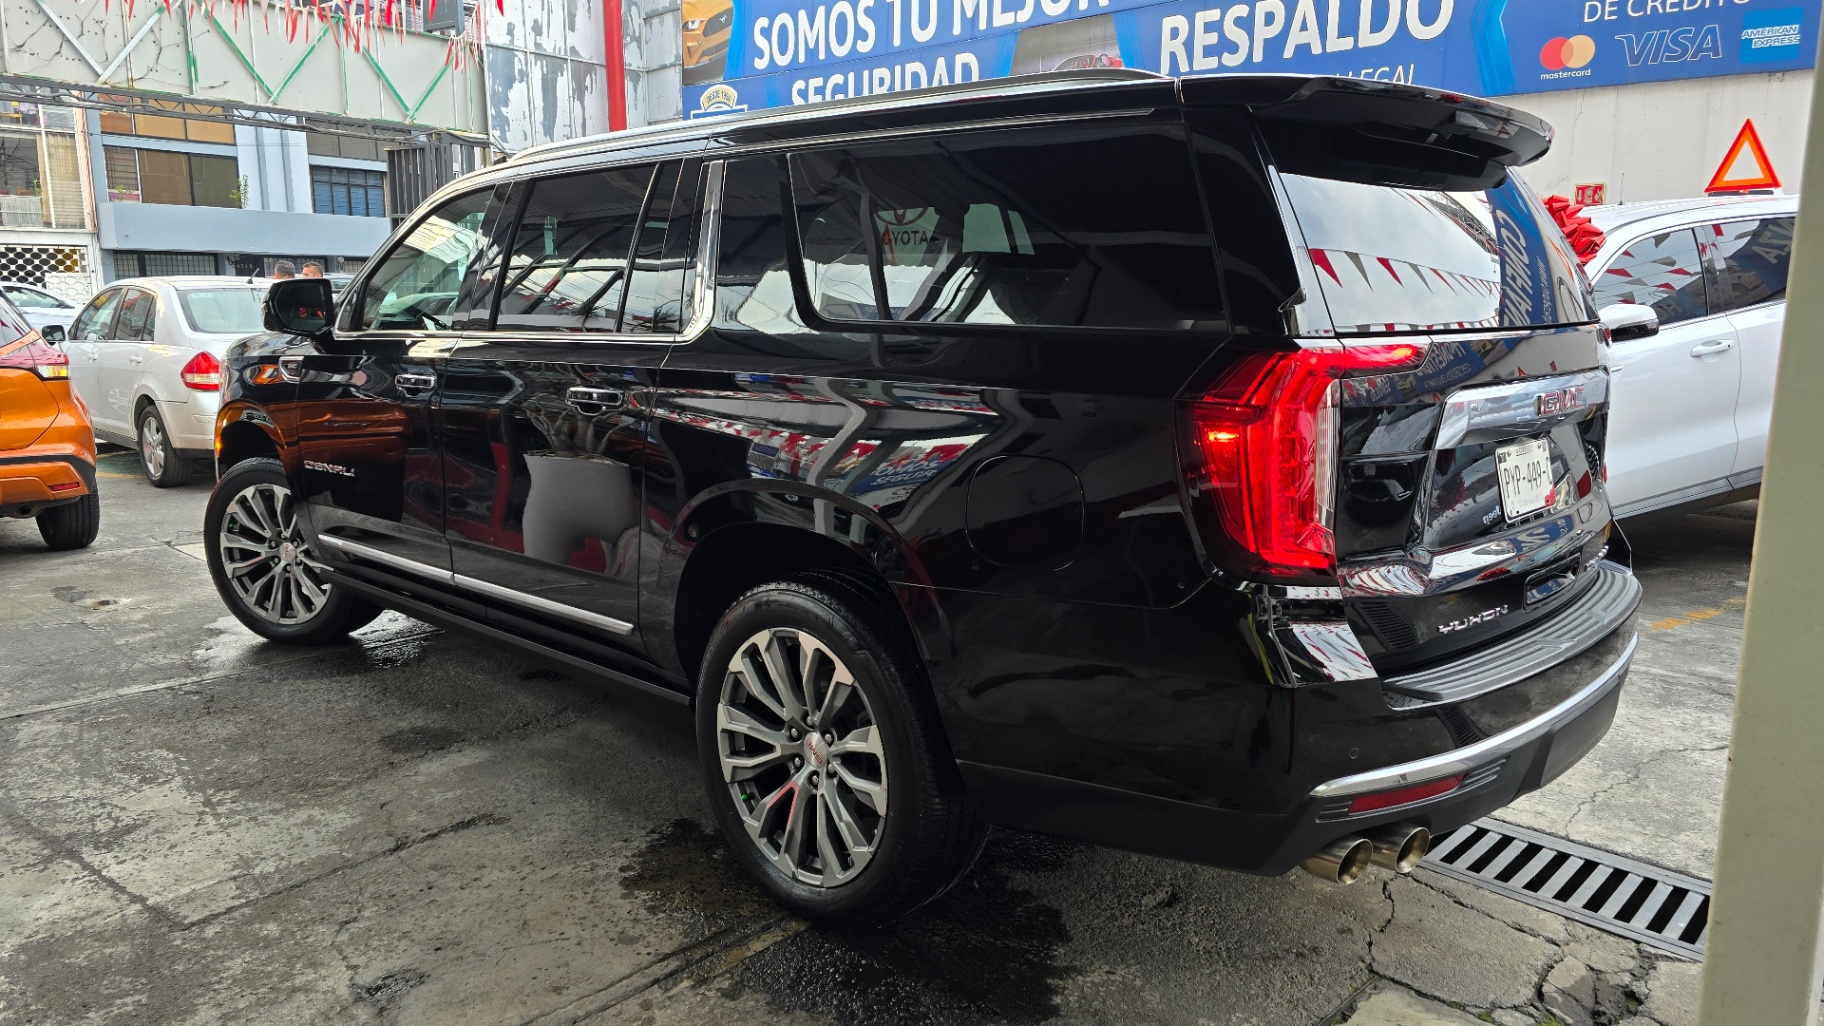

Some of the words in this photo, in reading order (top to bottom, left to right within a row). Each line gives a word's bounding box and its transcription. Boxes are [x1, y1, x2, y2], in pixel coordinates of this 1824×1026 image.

[1583, 1, 1618, 22] DE
[753, 0, 876, 70] SOMOS
[892, 0, 938, 47] TU
[1160, 0, 1454, 75] RESPALDO
[1742, 26, 1798, 38] AMERICAN
[1753, 36, 1800, 47] EXPRESS
[1615, 24, 1723, 67] VISA
[1540, 68, 1591, 80] mastercard
[1541, 387, 1585, 415] GMC
[303, 460, 355, 477] DENALI
[1437, 604, 1509, 635] YUKON
